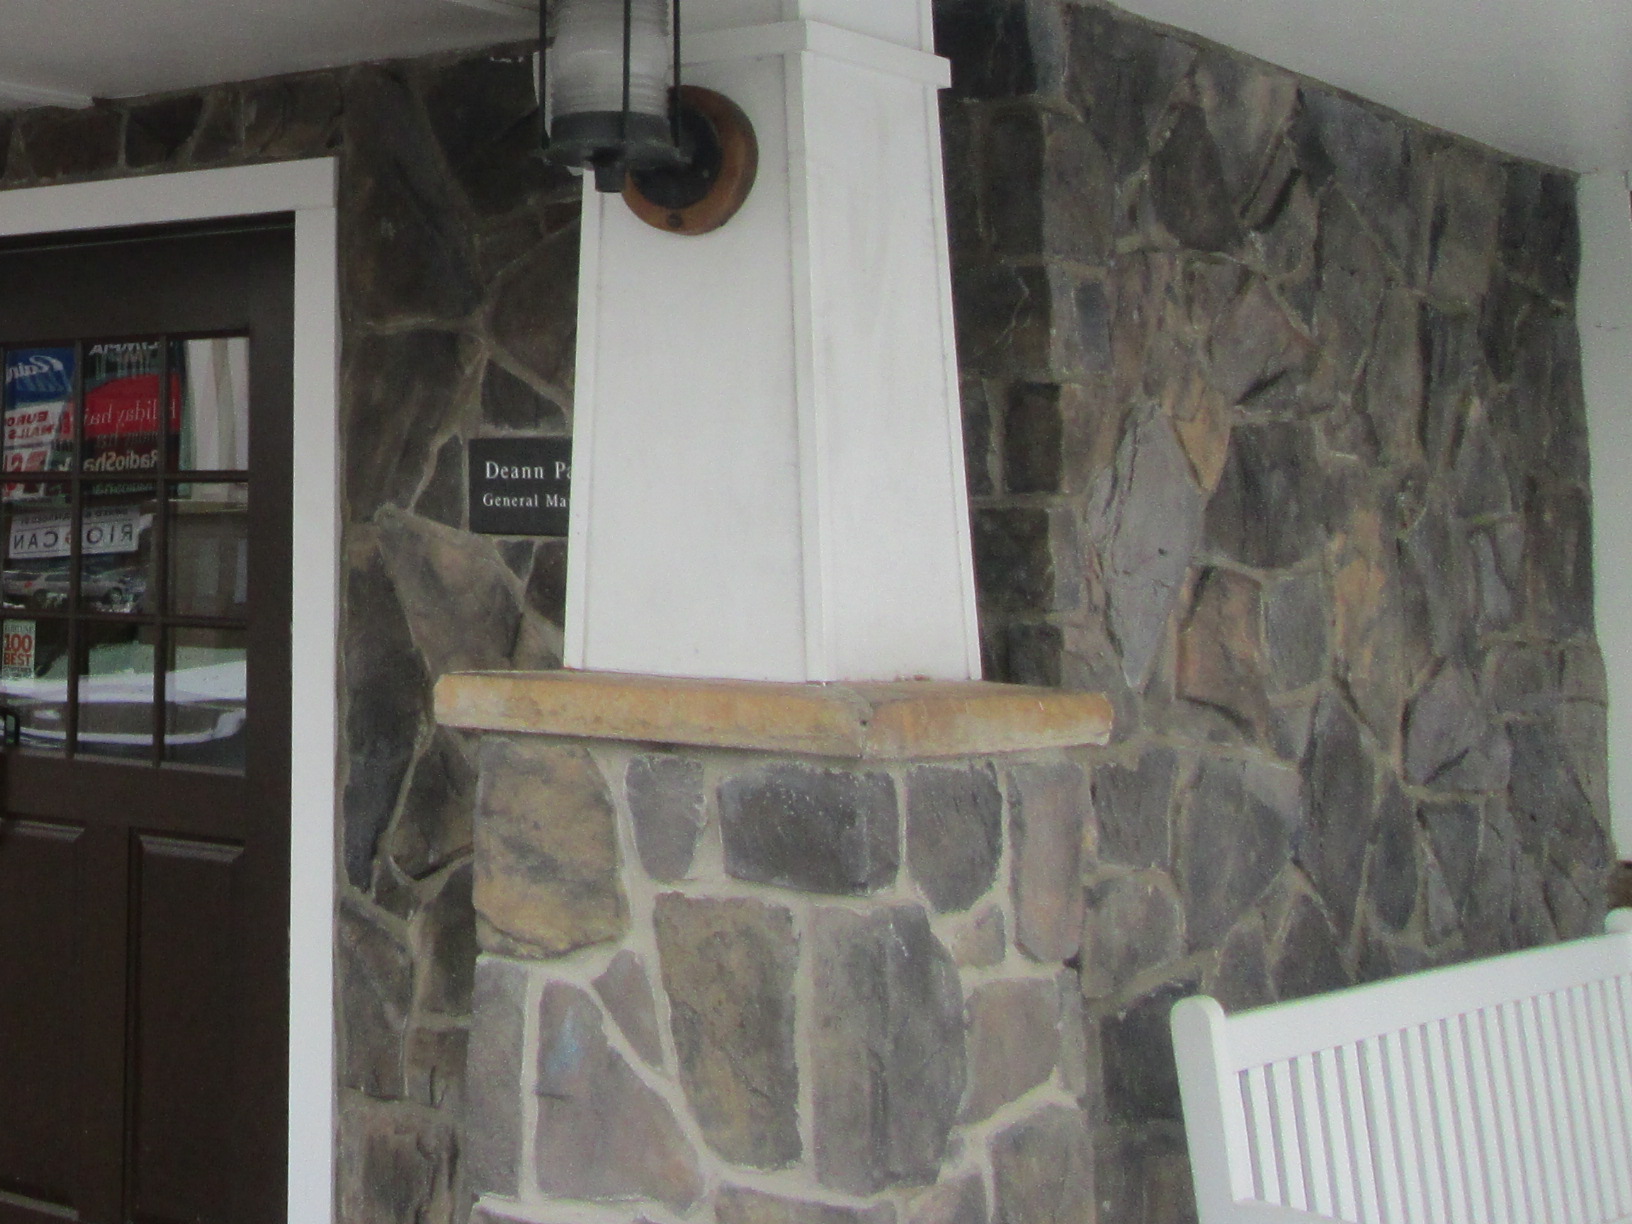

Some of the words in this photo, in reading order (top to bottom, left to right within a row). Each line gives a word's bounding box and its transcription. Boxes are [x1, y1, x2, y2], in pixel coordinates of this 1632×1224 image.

[485, 460, 544, 480] Deann
[482, 492, 539, 508] General
[545, 493, 567, 508] Ma
[4, 633, 33, 653] 100
[4, 653, 32, 667] BEST
